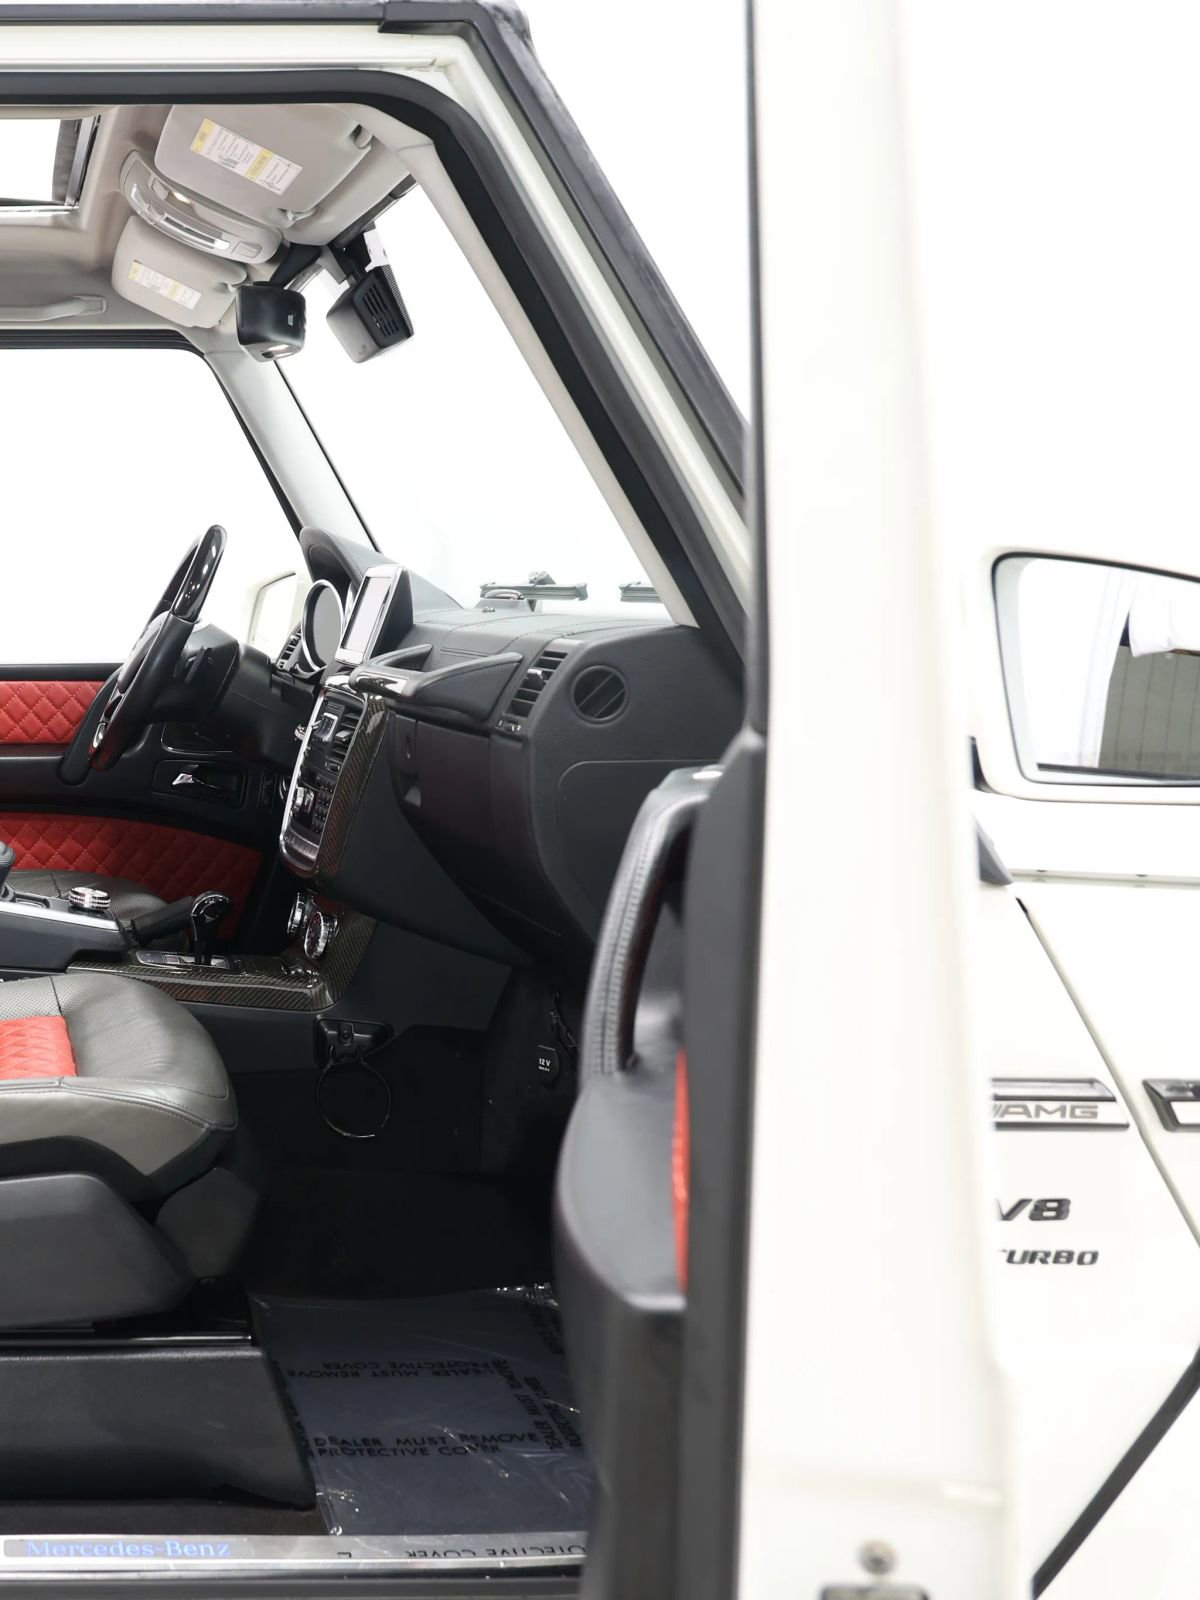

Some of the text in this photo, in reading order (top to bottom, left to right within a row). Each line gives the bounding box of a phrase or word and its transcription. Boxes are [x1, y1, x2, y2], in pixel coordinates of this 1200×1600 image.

[999, 1103, 1099, 1120] AMG
[996, 1197, 1072, 1222] V8
[1001, 1248, 1099, 1266] URBO
[287, 1369, 360, 1378] REMOVE
[322, 1361, 380, 1370] COVER
[371, 1369, 418, 1378] MUST
[514, 1393, 544, 1416] MUST
[314, 1432, 540, 1447] DEALER MUST REMOVE
[318, 1446, 430, 1457] PROTECTIVE
[27, 1540, 230, 1557] Mercedes-Benz
